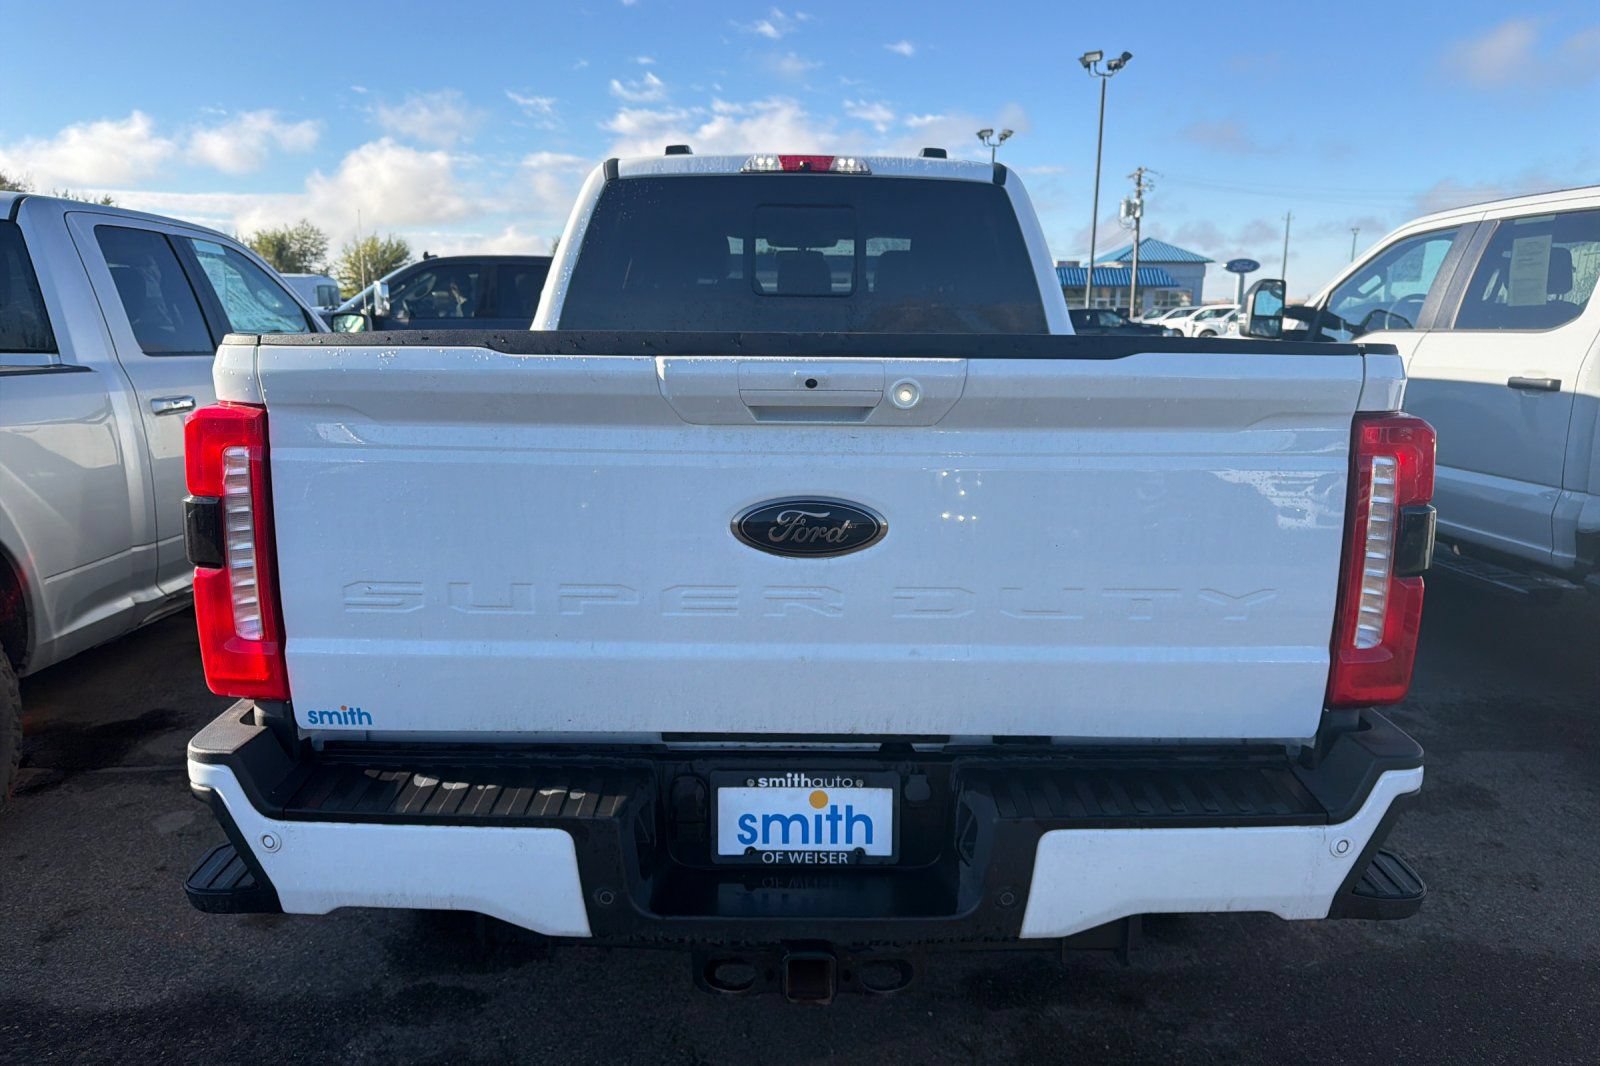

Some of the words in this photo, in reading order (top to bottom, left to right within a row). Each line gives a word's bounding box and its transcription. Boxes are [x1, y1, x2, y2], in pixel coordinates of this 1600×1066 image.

[767, 509, 850, 543] Ford
[343, 580, 843, 617] SUPER
[892, 586, 1278, 620] DUTY
[307, 705, 373, 725] smith
[737, 789, 873, 845] smith
[761, 851, 784, 864] OF
[788, 852, 849, 864] WEISER
